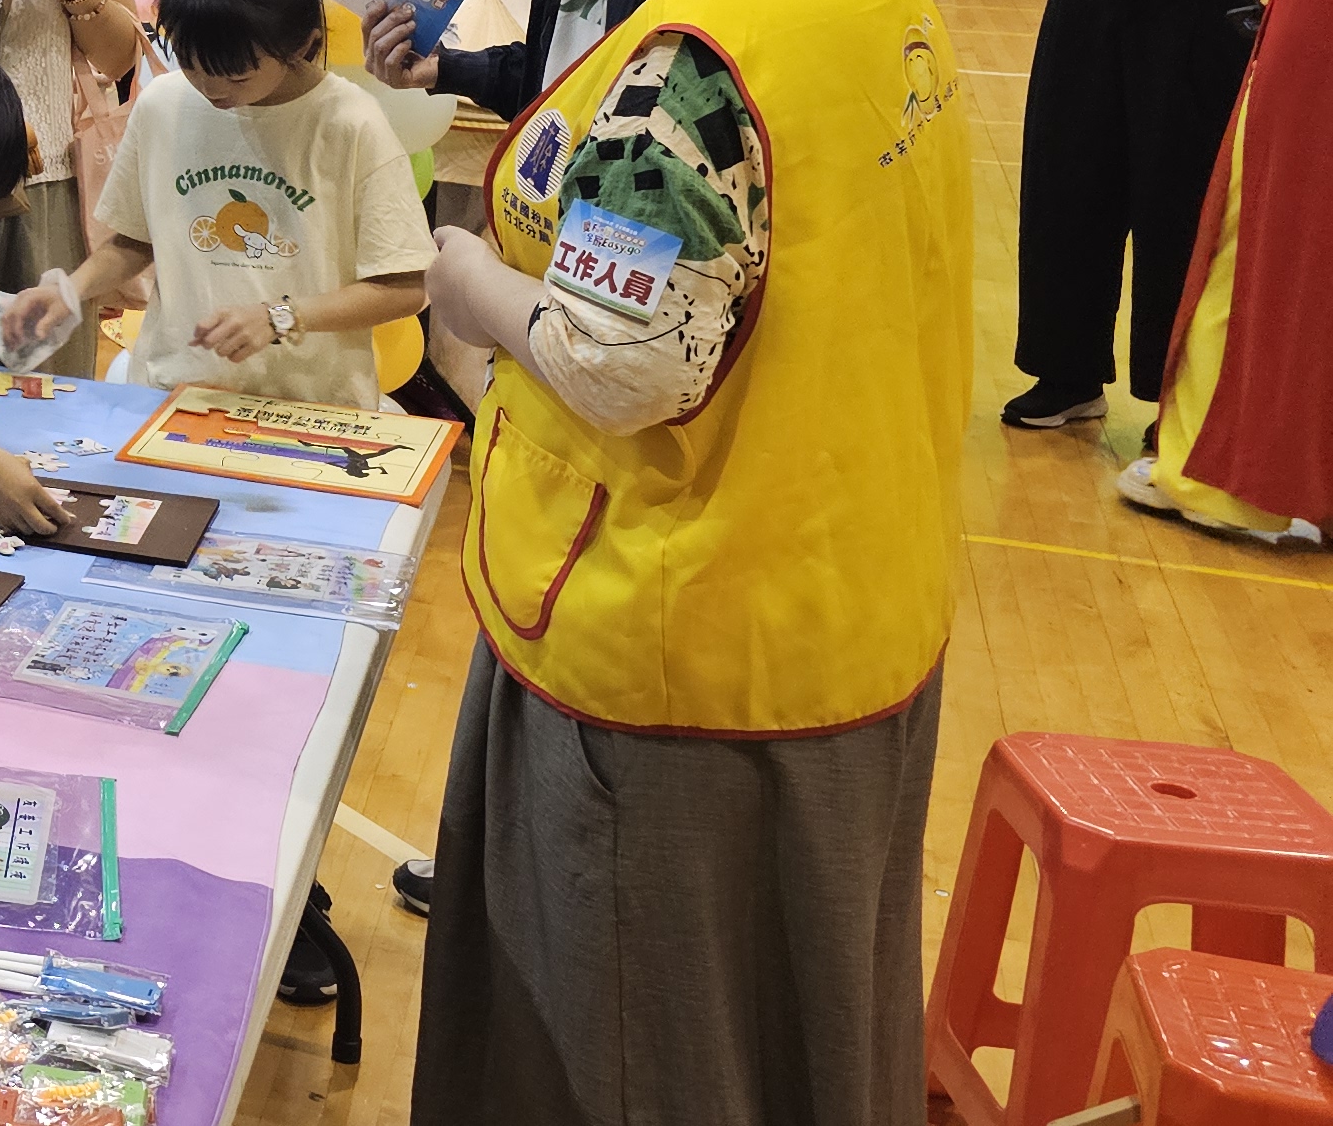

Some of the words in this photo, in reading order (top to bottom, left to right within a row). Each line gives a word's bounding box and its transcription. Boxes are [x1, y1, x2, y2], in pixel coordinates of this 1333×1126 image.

[175, 164, 317, 213] Cinnamoroll
[501, 186, 555, 235] 北區國稅局
[503, 209, 553, 247] 竹北分局
[553, 240, 656, 307] 工作人員
